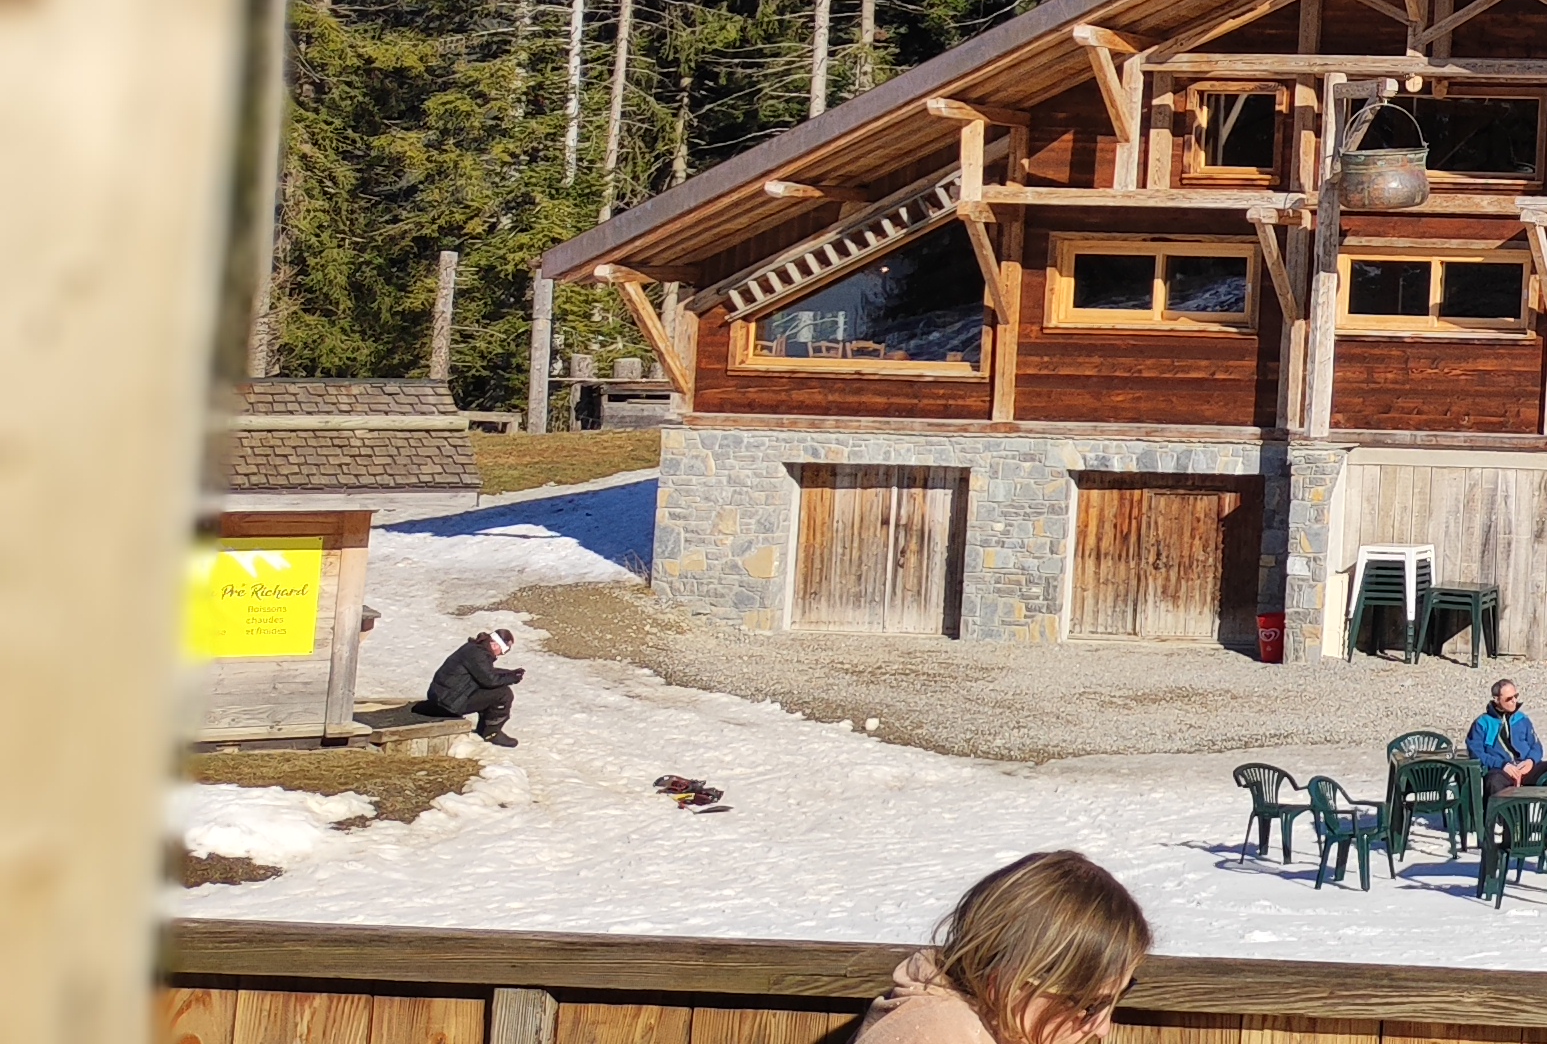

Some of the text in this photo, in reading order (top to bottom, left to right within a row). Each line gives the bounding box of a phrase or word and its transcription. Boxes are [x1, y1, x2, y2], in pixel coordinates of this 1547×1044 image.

[221, 583, 247, 600] Pré
[250, 582, 309, 601] Richard
[247, 605, 287, 613] Boissons
[245, 616, 284, 624] chaudes
